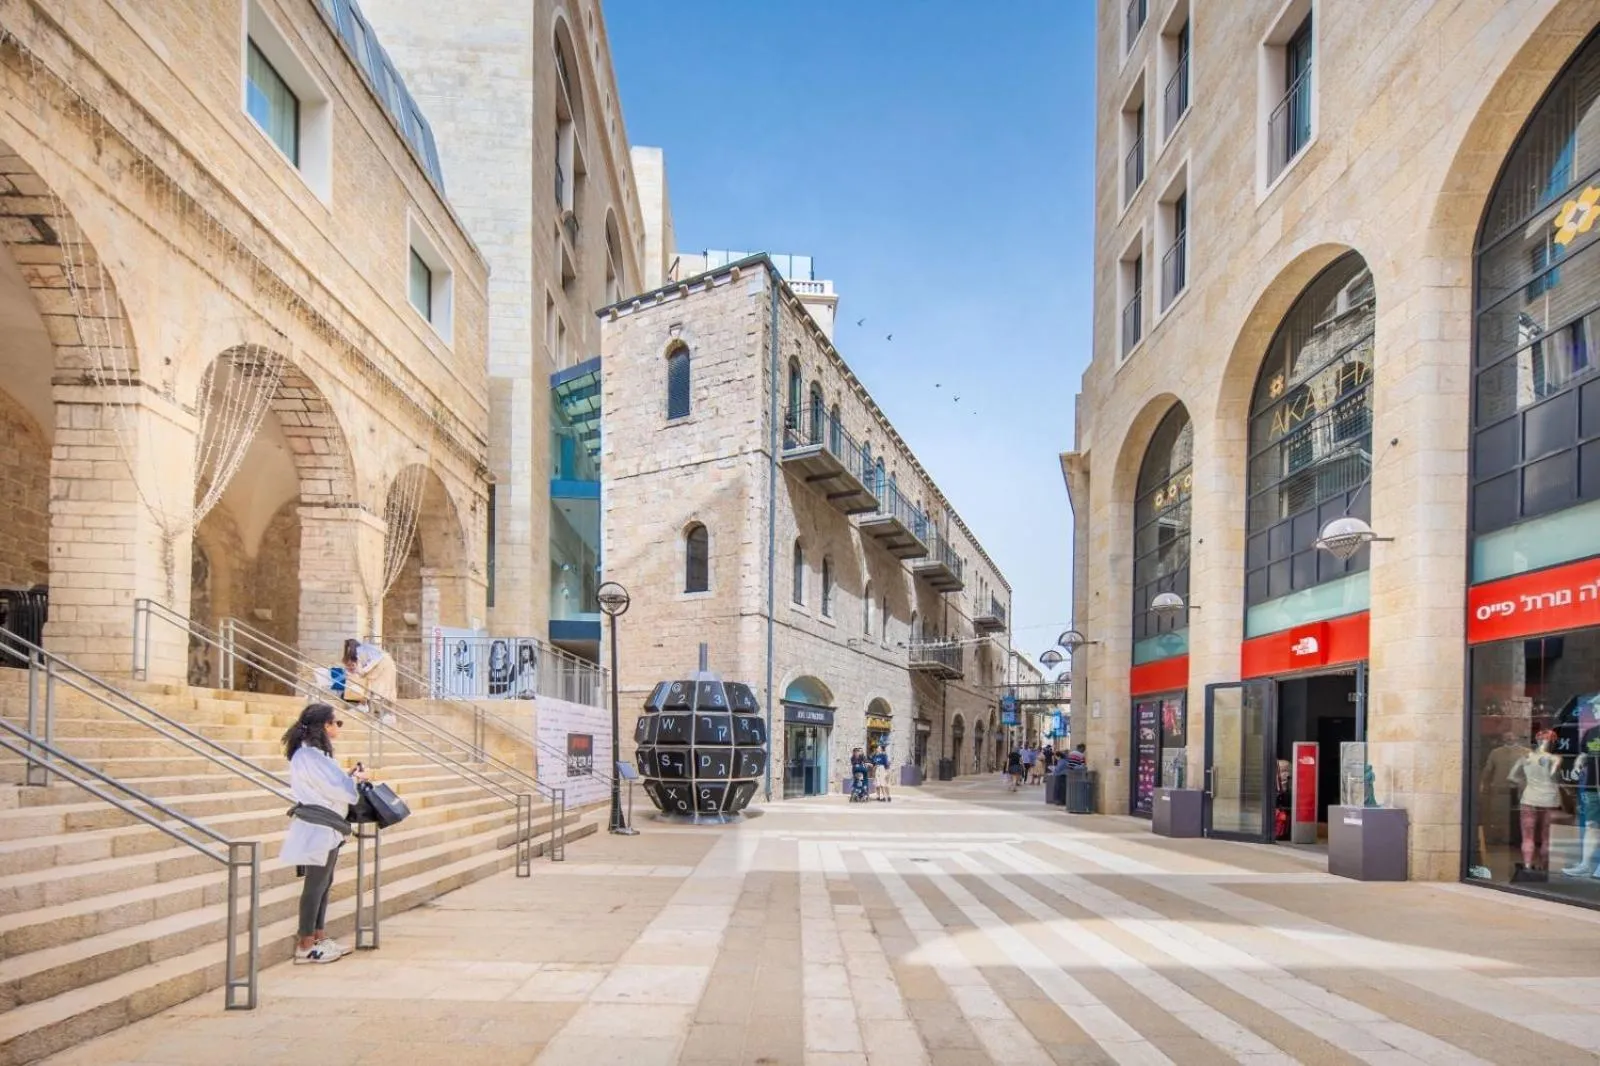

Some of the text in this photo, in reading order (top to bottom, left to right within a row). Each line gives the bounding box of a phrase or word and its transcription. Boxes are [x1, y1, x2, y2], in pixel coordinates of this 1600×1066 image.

[1579, 578, 1600, 601] ה
[1476, 600, 1516, 620] פייס
[677, 694, 686, 704] 2
[713, 694, 722, 705] 3
[662, 717, 675, 730] W
[717, 726, 728, 742] ק
[661, 754, 671, 767] S
[701, 755, 711, 767] D
[674, 763, 683, 775] ד
[718, 763, 726, 775] ג
[667, 787, 678, 799] X
[701, 788, 711, 799] C
[707, 800, 718, 810] ב
